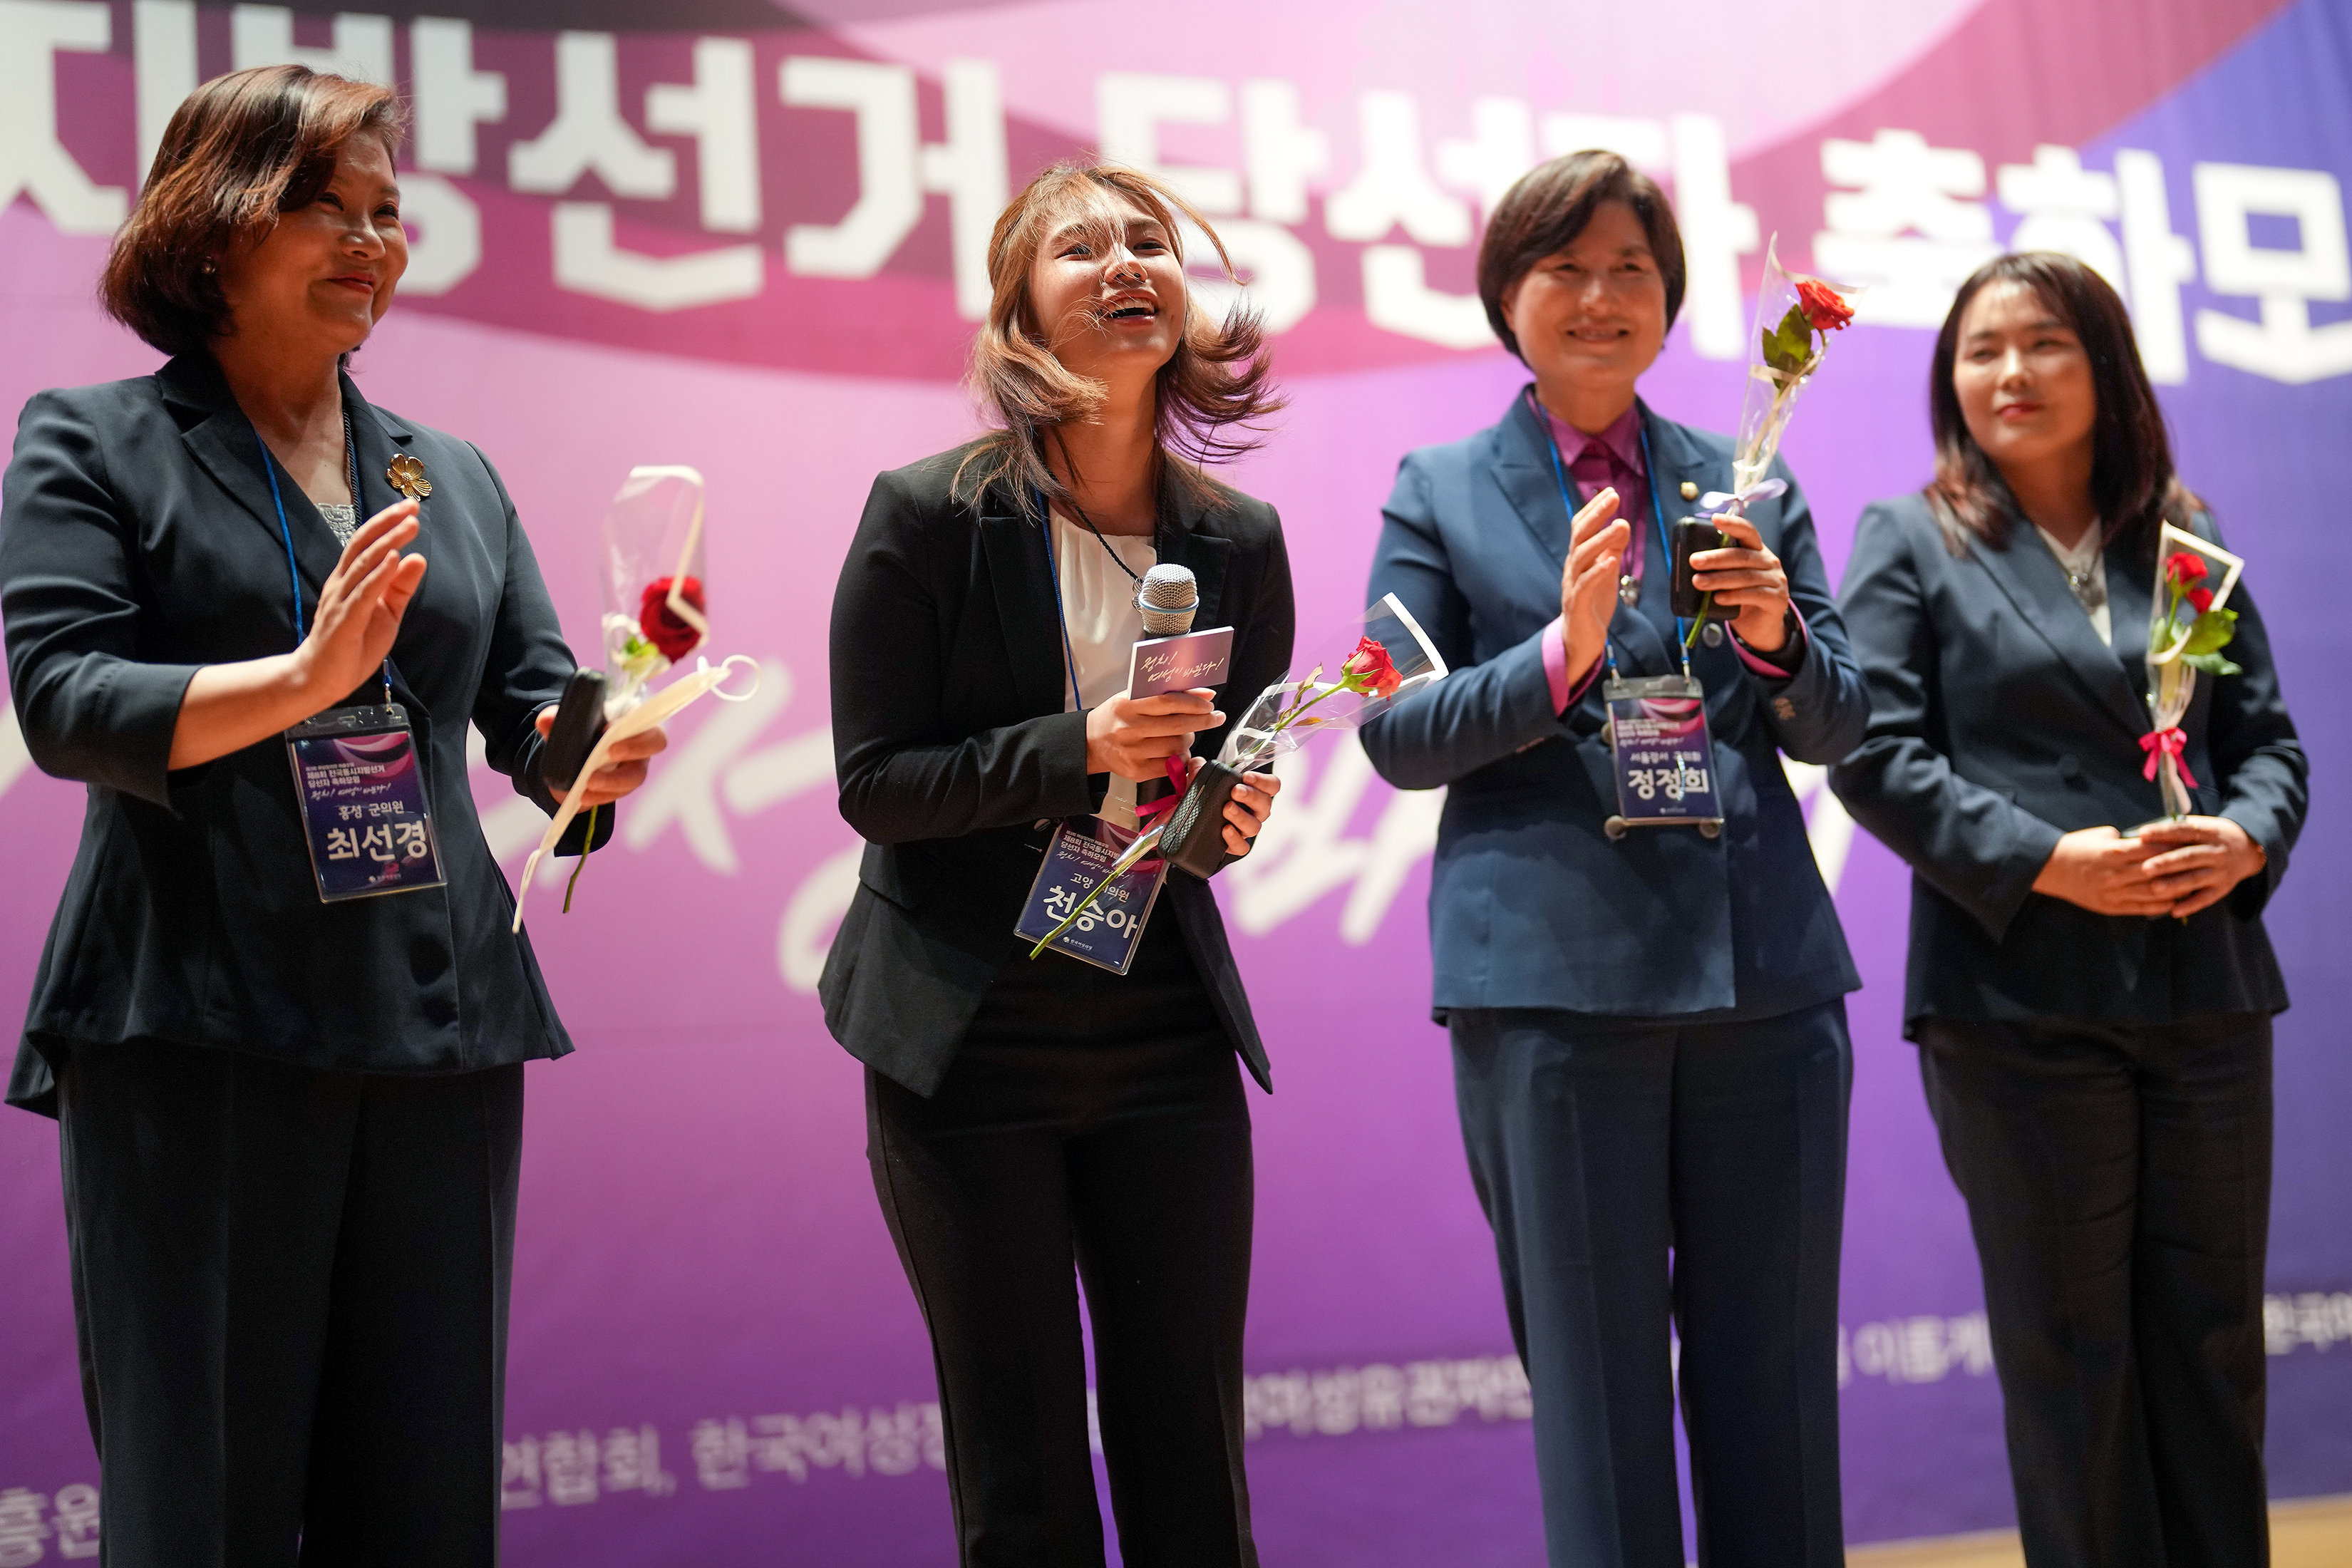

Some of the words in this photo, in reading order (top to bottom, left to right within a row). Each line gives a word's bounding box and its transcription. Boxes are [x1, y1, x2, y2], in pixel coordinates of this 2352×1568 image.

[1140, 651, 1177, 672] 정치!
[1147, 666, 1183, 682] 여성이
[1182, 657, 1224, 677] 바꾼다!
[1627, 766, 1710, 800] 정정희
[339, 805, 362, 820] 홍성
[368, 800, 405, 817] 군의원
[326, 820, 428, 862] 최선경
[1061, 841, 1081, 853] 당선자
[1081, 848, 1107, 862] 축하모임
[1070, 872, 1094, 889] 고양
[1043, 884, 1138, 939] 천승아
